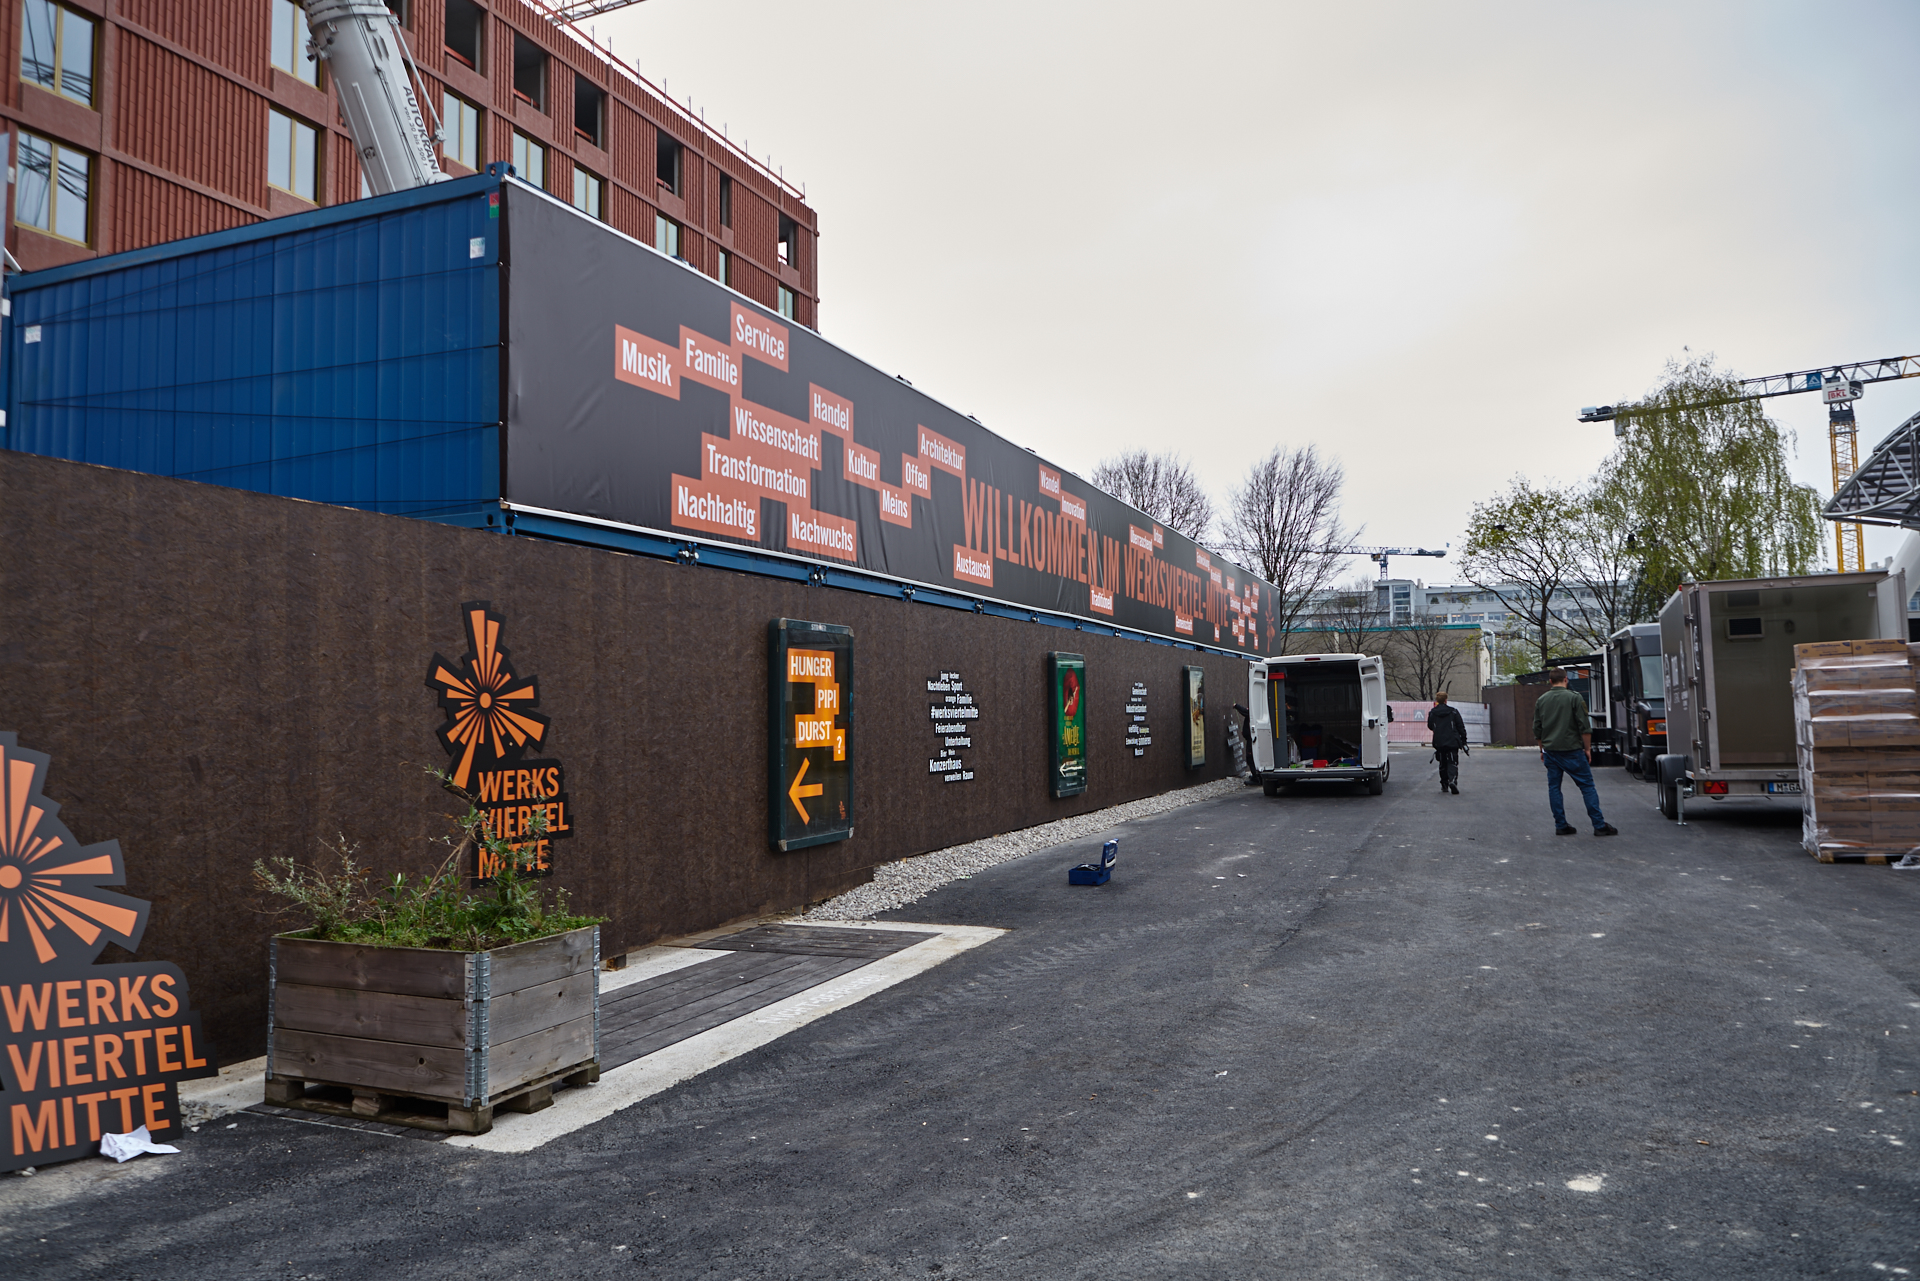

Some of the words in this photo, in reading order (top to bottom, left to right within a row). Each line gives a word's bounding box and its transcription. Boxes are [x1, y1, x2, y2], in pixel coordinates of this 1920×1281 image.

[403, 86, 441, 174] AUTOKRAN
[735, 314, 785, 361] Service
[622, 338, 672, 387] Musik
[685, 337, 738, 386] Familie
[813, 393, 849, 432] Handel
[735, 406, 819, 462] Wissenschaft
[920, 433, 964, 471] Architektur
[707, 444, 807, 499] Transformation
[848, 449, 877, 482] Kultur
[905, 462, 928, 491] Offen
[1040, 470, 1060, 495] Wandel
[678, 486, 756, 536] Nachhaltig
[882, 490, 908, 519] Meins
[1061, 495, 1085, 521] Innovation
[791, 513, 853, 553] Nachwuchs
[961, 475, 1098, 587] WILLKOMMEN
[1103, 535, 1120, 594] IM
[1124, 544, 1228, 628] WERKSVIERTEL-MITTE
[955, 551, 991, 580] Austausch
[791, 656, 832, 677] HUNGER
[818, 689, 837, 709] PIPI
[798, 721, 832, 741] DURST
[836, 735, 843, 754] ?
[929, 758, 962, 772] Konzerthaus
[478, 767, 560, 803] WERKS
[0, 973, 179, 1034] WERKS
[6, 1024, 207, 1093] VIERTEL
[11, 1083, 171, 1156] MITTE
